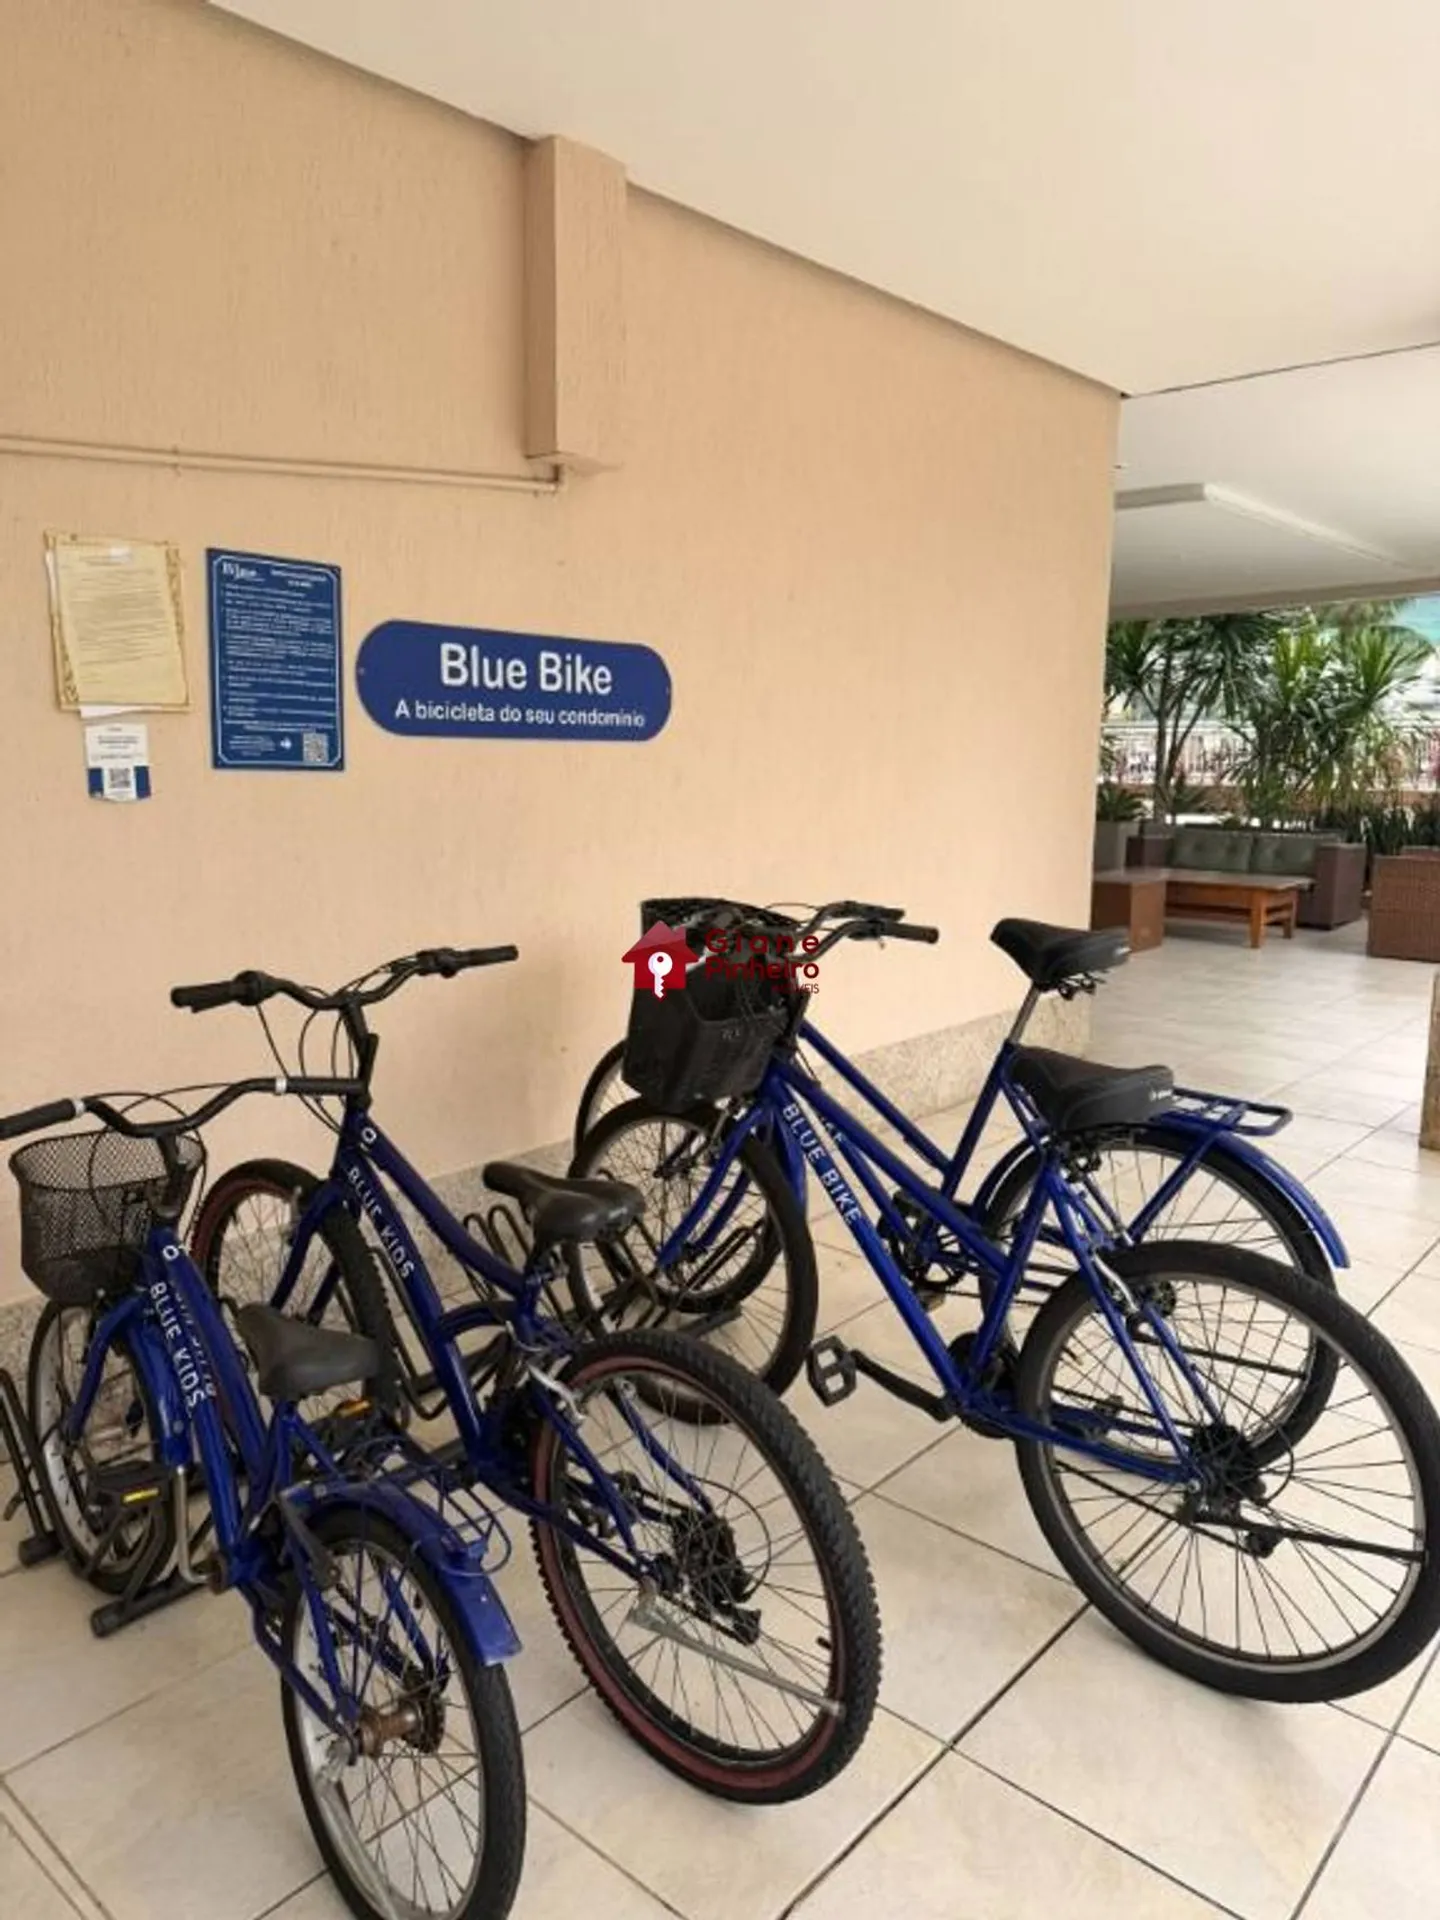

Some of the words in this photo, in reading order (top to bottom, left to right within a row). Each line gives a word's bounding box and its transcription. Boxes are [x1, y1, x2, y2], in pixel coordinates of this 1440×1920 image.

[395, 699, 411, 719] A
[415, 700, 496, 723] bicicleta
[499, 703, 522, 723] do
[525, 706, 555, 724] seu
[439, 642, 528, 690] Blue
[539, 650, 613, 695] Bike
[782, 1103, 827, 1163] BLUE
[821, 1168, 862, 1226] BIKE
[348, 1166, 383, 1220] BLUE
[381, 1225, 415, 1278] KIDS
[150, 1281, 182, 1340] BLUE
[172, 1347, 207, 1408] KIDS
